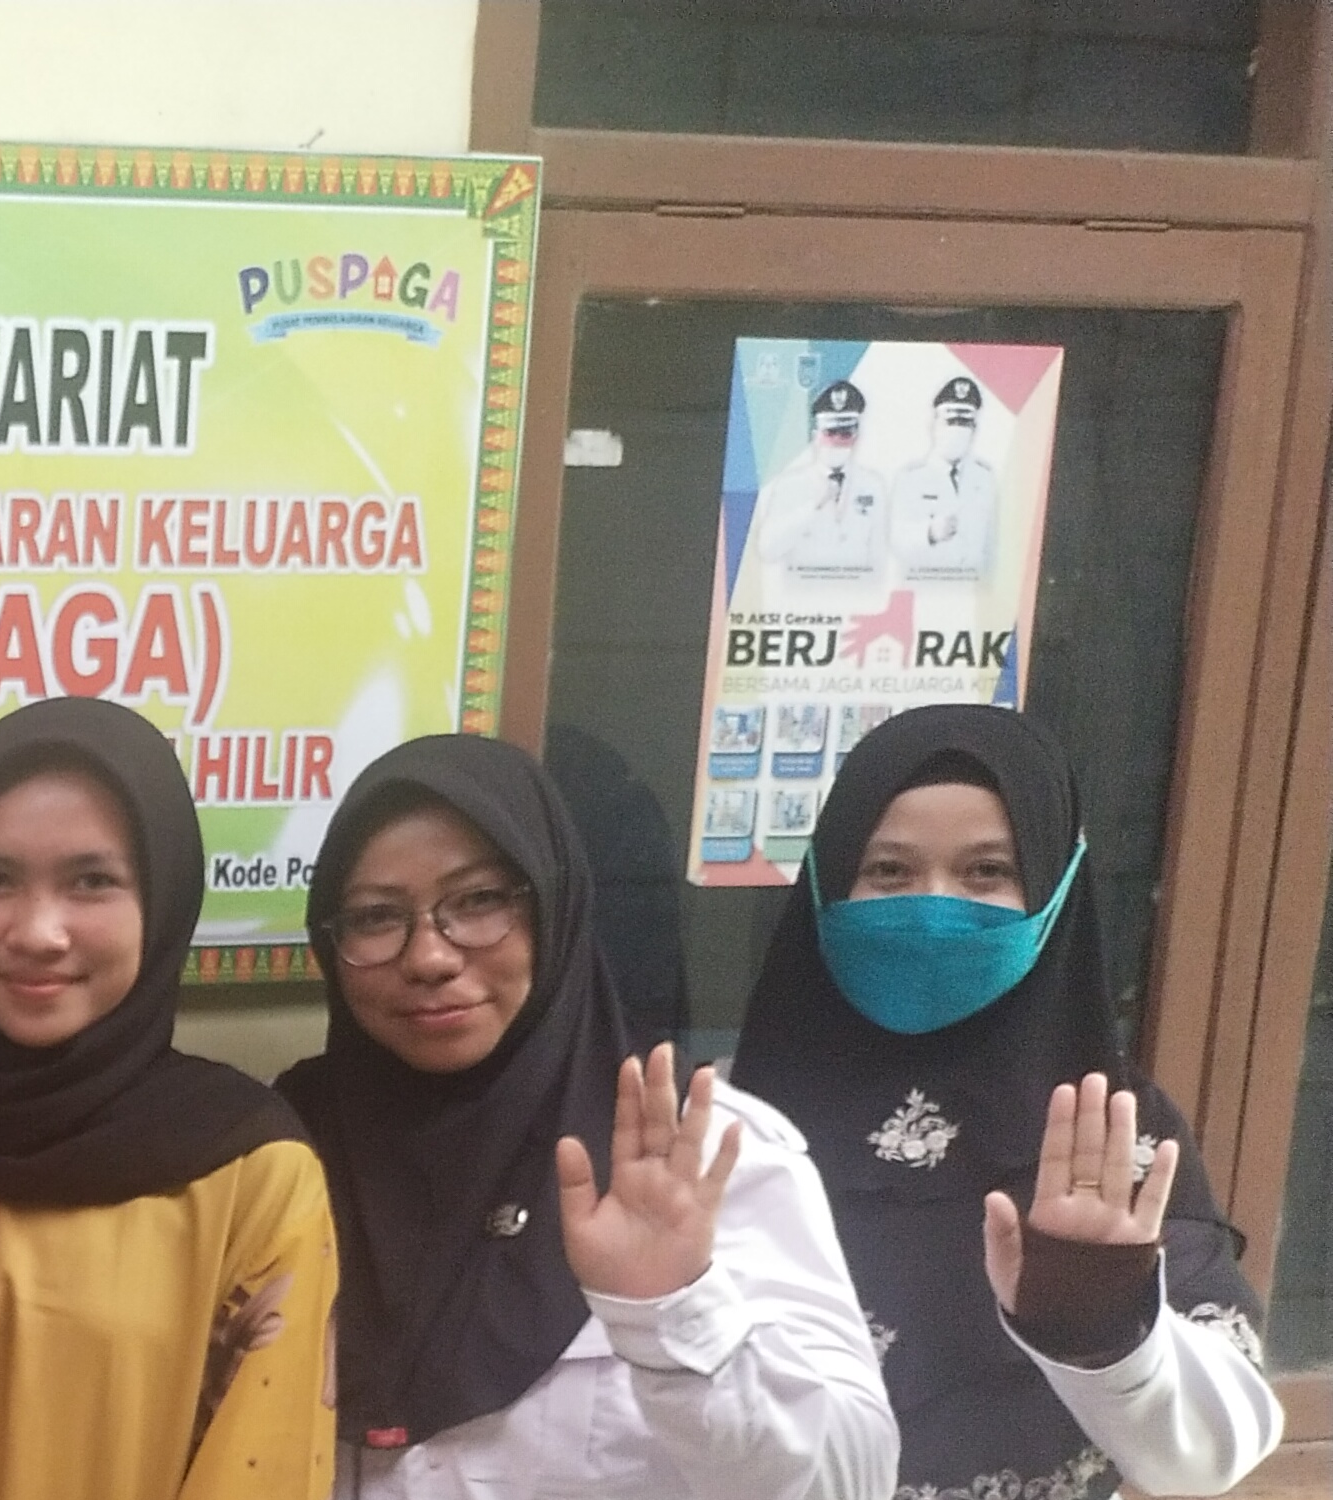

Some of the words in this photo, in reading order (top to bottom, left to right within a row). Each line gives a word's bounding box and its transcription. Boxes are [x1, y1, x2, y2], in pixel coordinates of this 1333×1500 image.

[138, 500, 423, 570] KELUARGA
[748, 613, 781, 624] AKSI
[785, 613, 842, 624] Gerakan
[723, 676, 811, 693] BERSAMA
[817, 677, 862, 693] JAGA
[870, 677, 964, 693] KELUARGA
[194, 735, 334, 800] HILIR
[213, 857, 277, 888] Kode
[286, 857, 316, 887] Po
